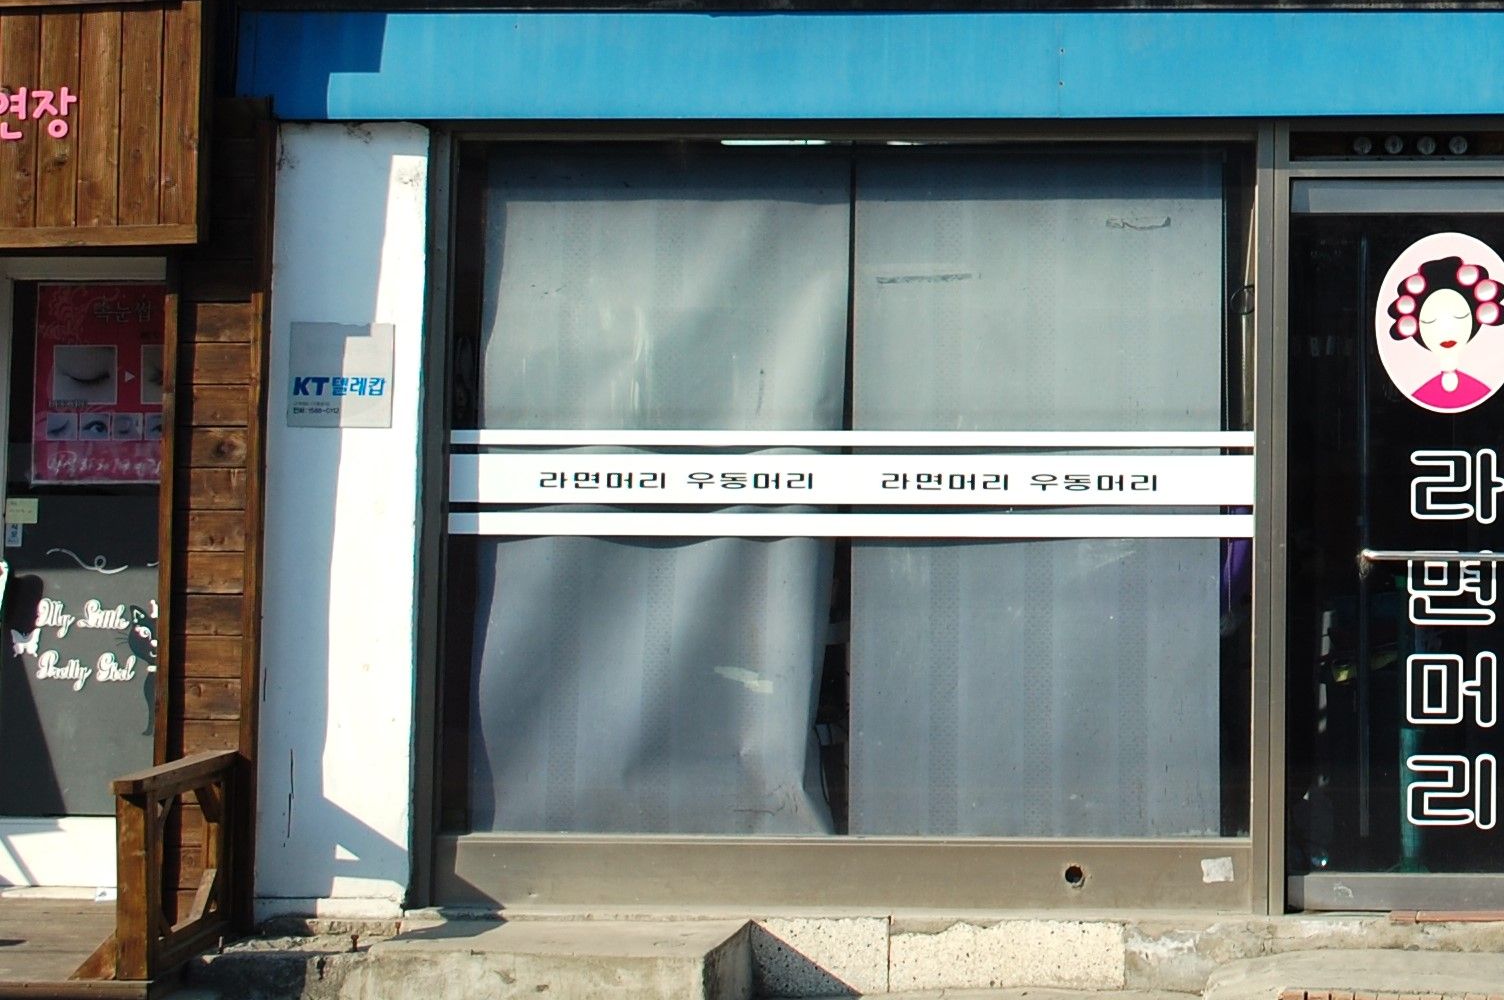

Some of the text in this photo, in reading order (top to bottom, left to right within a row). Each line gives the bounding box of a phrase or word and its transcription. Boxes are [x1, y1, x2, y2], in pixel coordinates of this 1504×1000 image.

[0, 86, 78, 140] 연장
[540, 471, 1158, 492] 라면머리 우동머리 라면머리 우동머리
[36, 597, 130, 638] My Little
[36, 650, 137, 692] Pretty Girl
